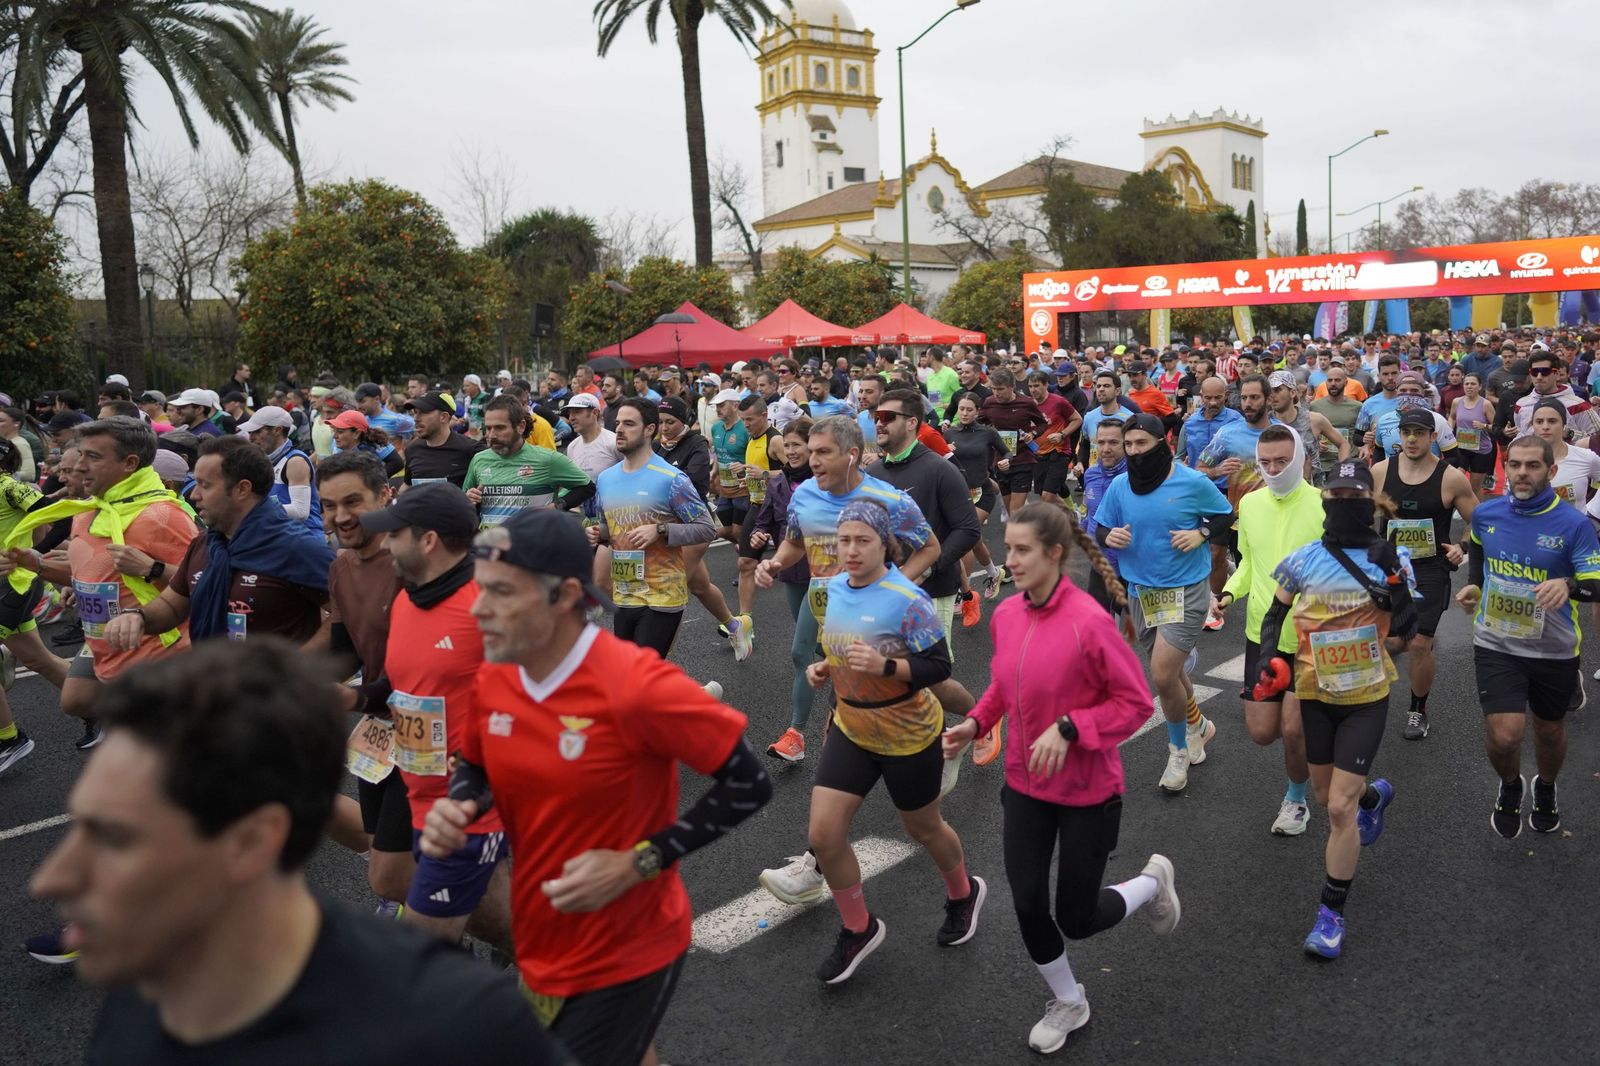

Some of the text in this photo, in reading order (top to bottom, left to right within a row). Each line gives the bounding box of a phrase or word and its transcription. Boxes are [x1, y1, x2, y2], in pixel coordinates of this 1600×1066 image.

[1444, 259, 1502, 279] HOKA
[1510, 268, 1554, 279] HYUNDAI
[1177, 276, 1221, 294] HOKA
[483, 485, 523, 495] ATLETISMO
[1488, 557, 1548, 583] TUSSAM
[1144, 590, 1176, 607] 12869
[1490, 593, 1534, 617] 13390
[1318, 641, 1371, 665] 13215
